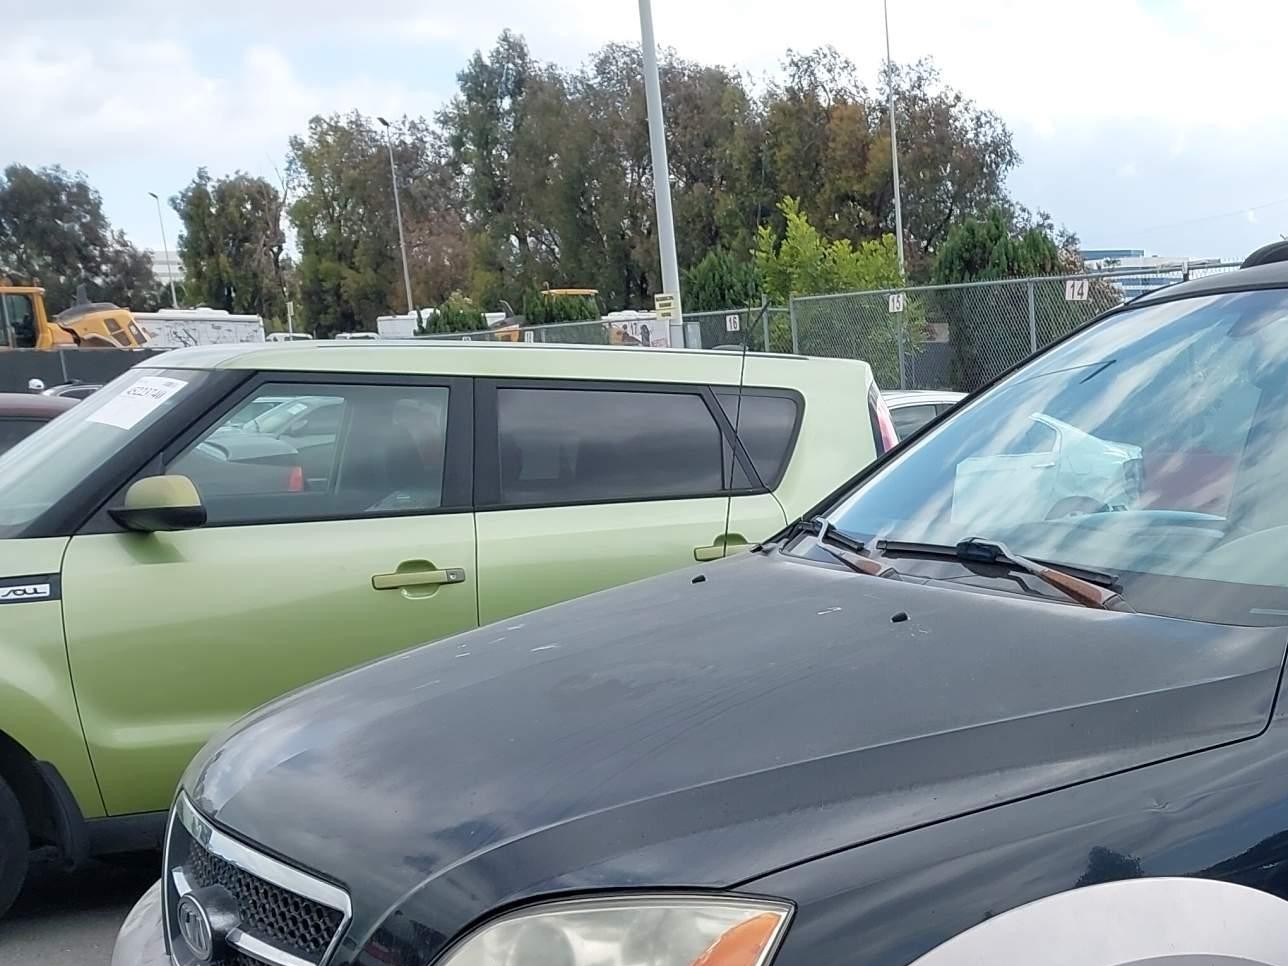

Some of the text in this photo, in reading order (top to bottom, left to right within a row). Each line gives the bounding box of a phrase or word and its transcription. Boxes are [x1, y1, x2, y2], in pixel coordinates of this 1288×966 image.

[1070, 284, 1086, 300] 14
[891, 295, 903, 312] 15
[728, 316, 738, 330] 16
